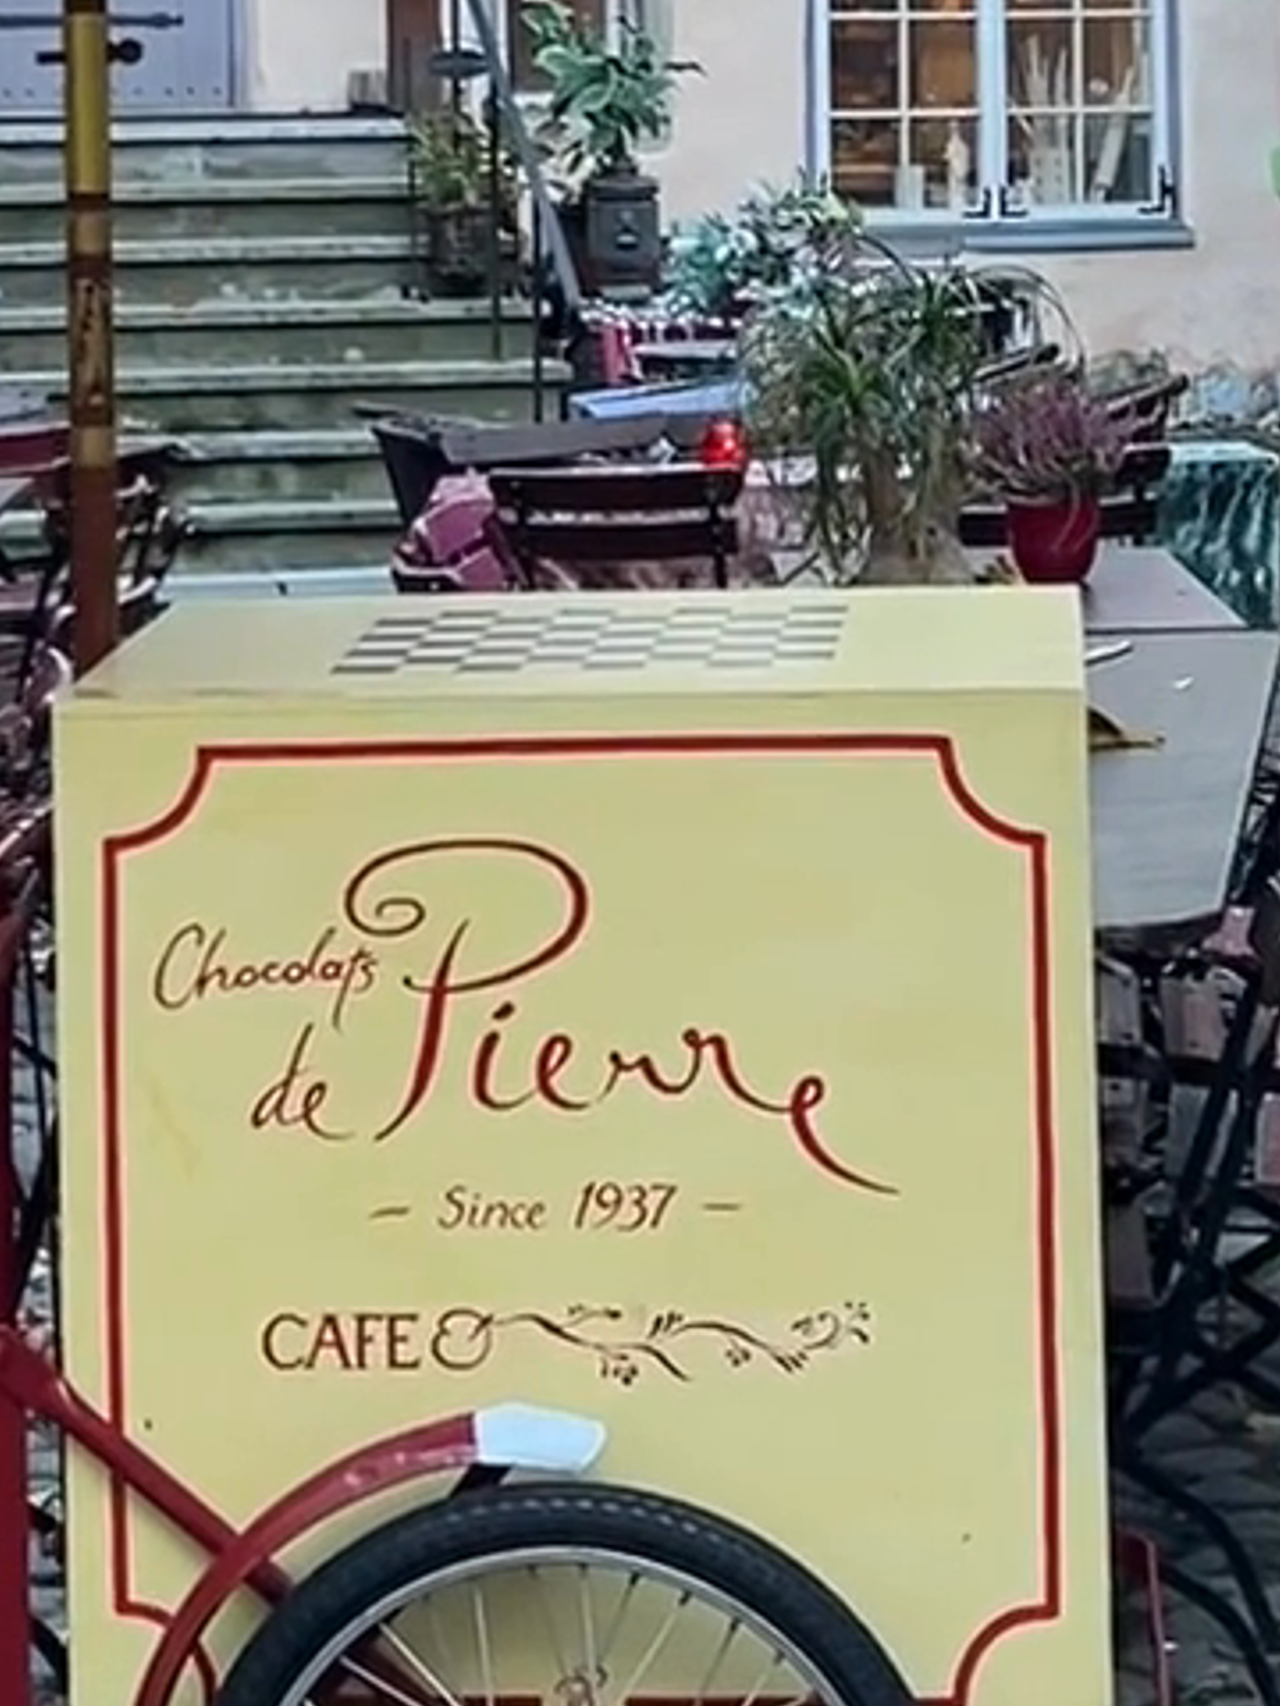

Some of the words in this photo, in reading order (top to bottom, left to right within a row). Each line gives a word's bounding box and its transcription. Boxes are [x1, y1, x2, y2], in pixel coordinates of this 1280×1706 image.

[153, 923, 378, 1033] Chocolats
[251, 1022, 357, 1140] de
[344, 838, 901, 1196] Pierre
[437, 1185, 547, 1231] Since
[574, 1183, 678, 1232] 1937
[262, 1312, 420, 1372] CAFE
